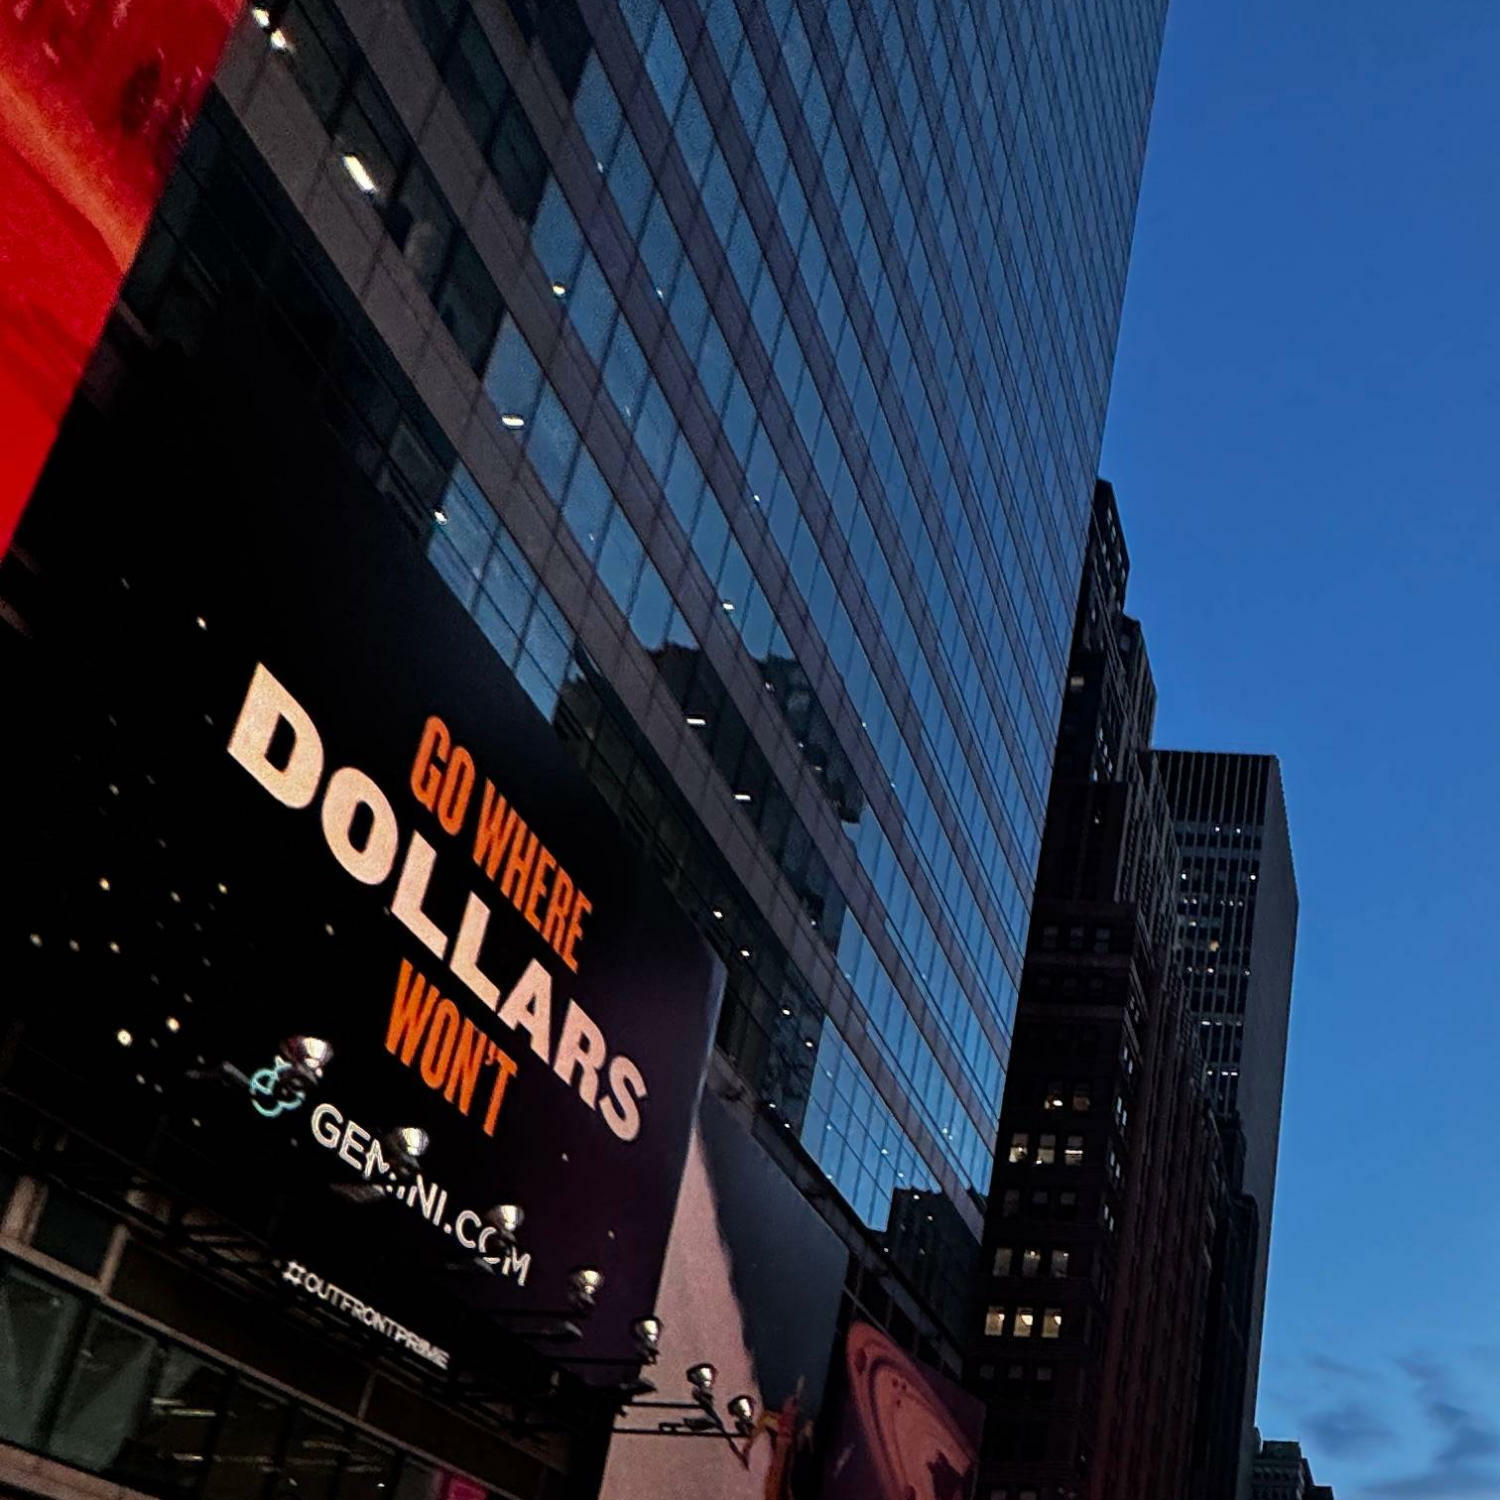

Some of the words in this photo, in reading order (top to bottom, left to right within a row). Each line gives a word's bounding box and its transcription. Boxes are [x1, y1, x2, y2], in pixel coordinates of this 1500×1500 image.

[227, 661, 648, 1142] DOLLARS
[410, 715, 476, 836] GO
[473, 777, 592, 973] WHERE
[384, 958, 518, 1138] WON'T
